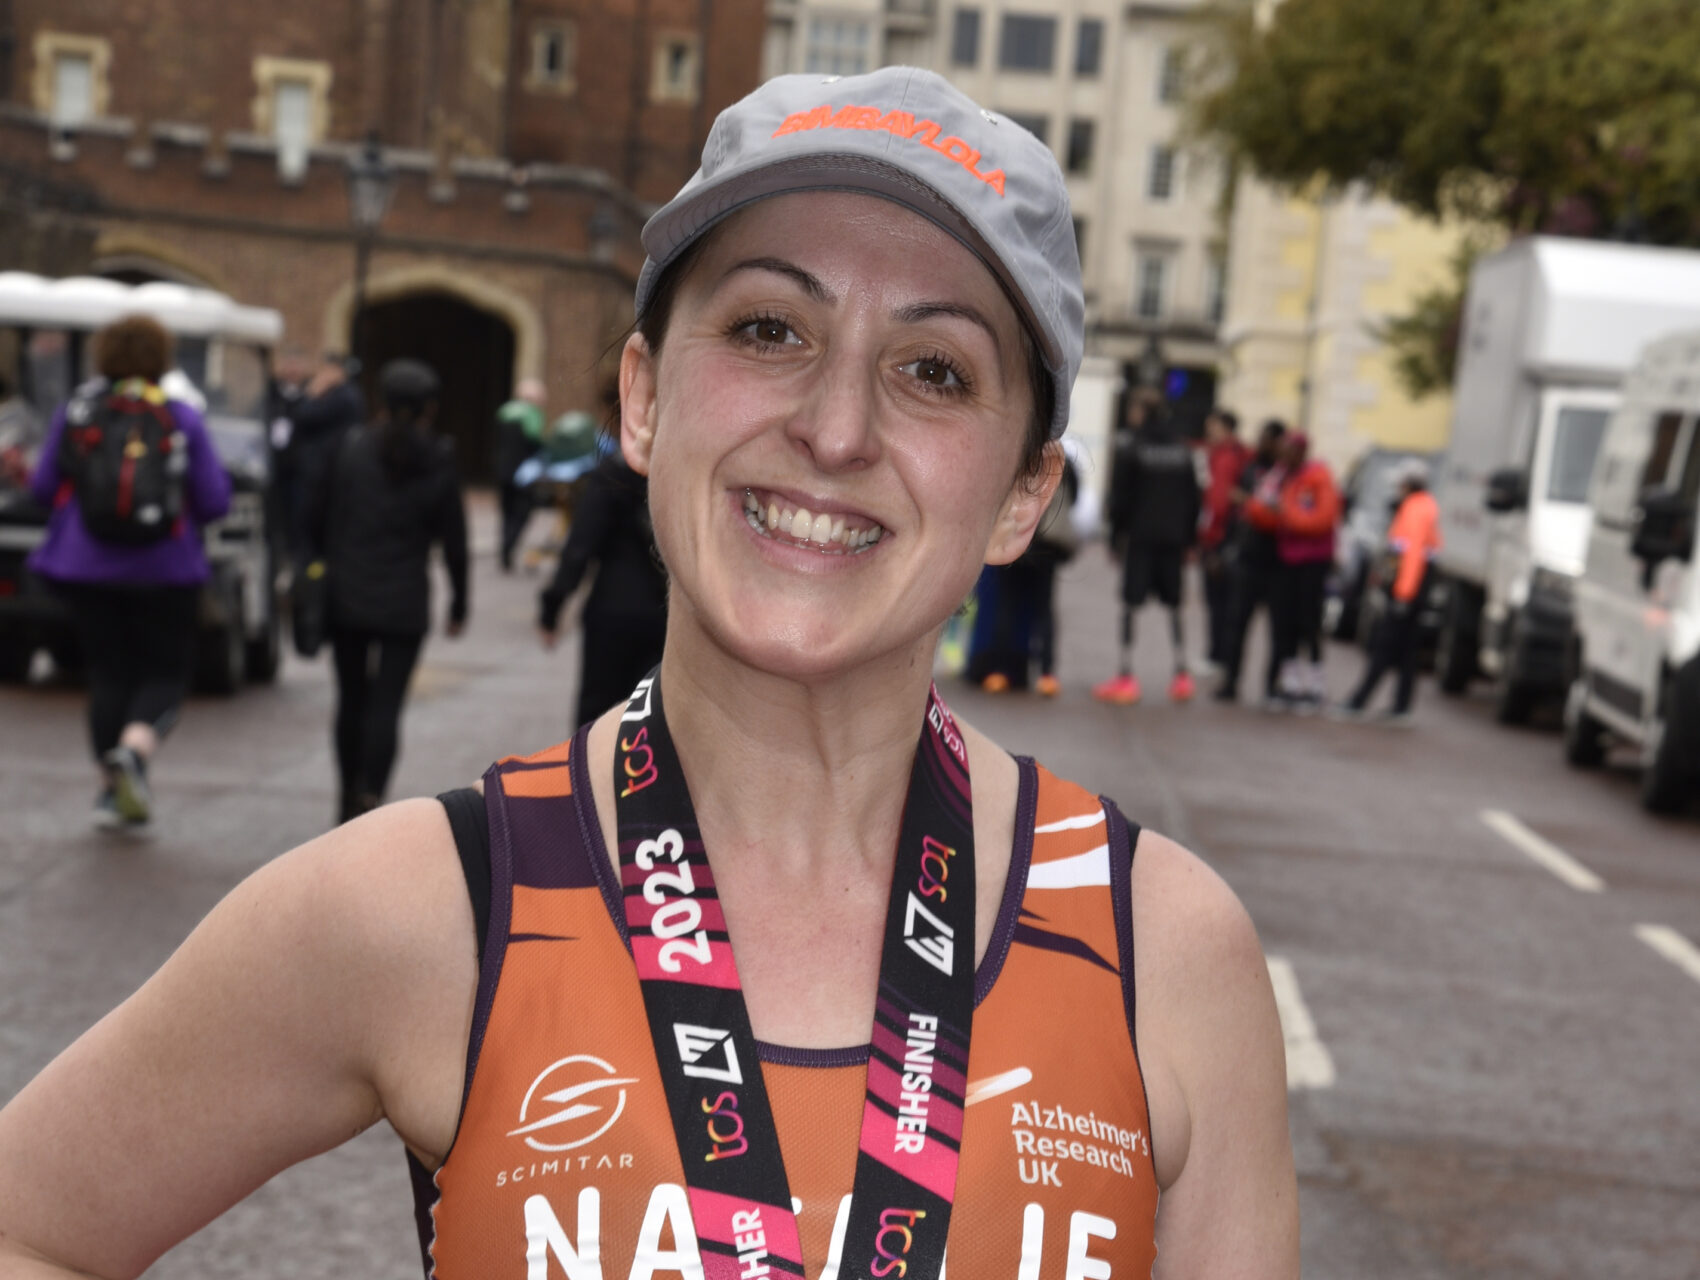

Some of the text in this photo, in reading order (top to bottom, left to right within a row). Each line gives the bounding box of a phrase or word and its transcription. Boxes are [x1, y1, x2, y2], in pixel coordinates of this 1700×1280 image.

[620, 726, 659, 799] tcs
[634, 828, 713, 974] 2023
[918, 834, 957, 904] tcs
[893, 1012, 939, 1155] FINISHER
[701, 1090, 749, 1163] tcs
[1010, 1099, 1149, 1157] Alzheimer's
[1011, 1128, 1134, 1179] Research
[495, 1152, 635, 1188] SCIMITAR
[1017, 1158, 1063, 1188] UK
[869, 1206, 927, 1280] tcs
